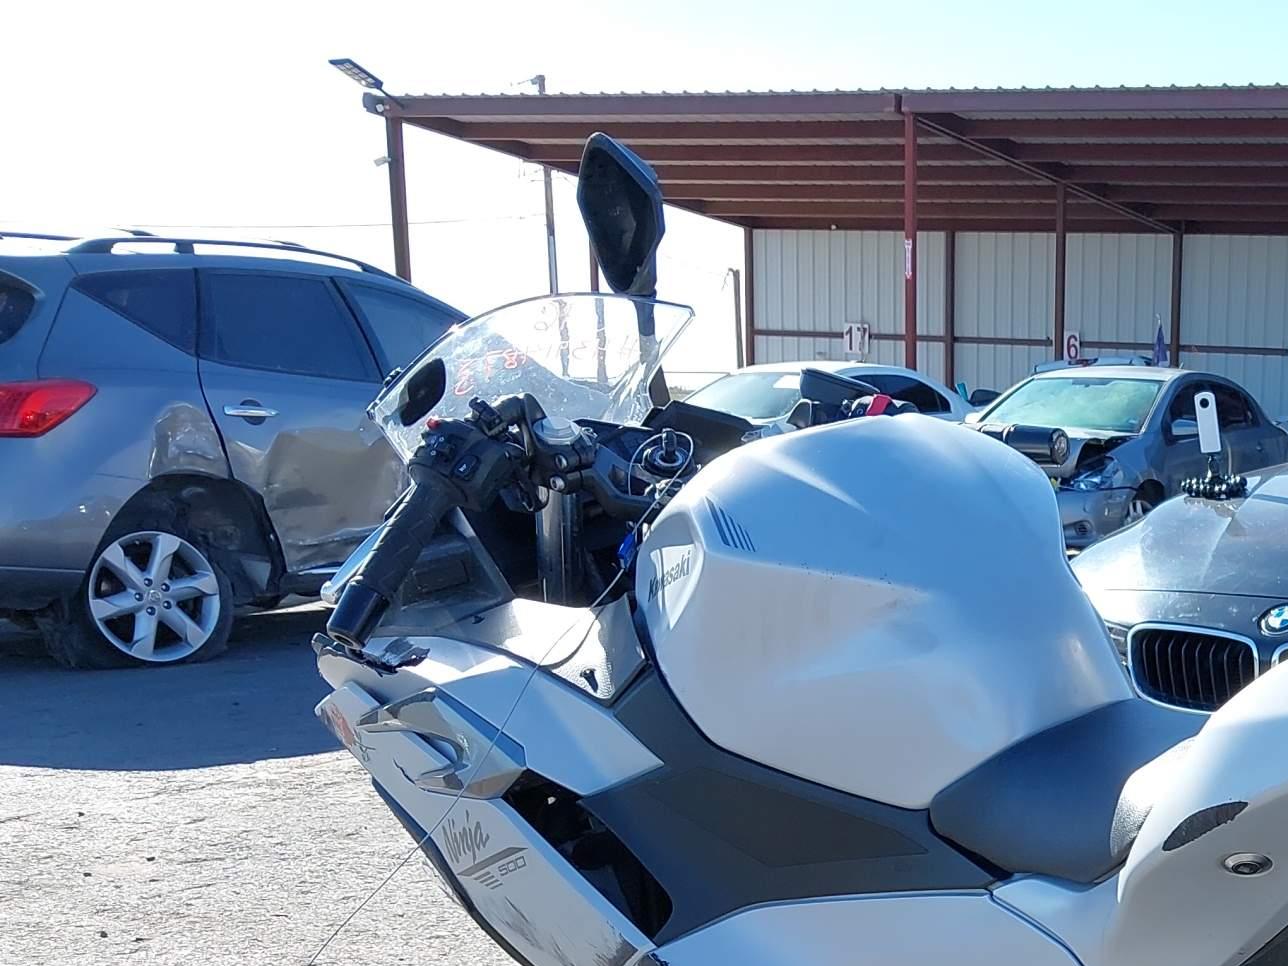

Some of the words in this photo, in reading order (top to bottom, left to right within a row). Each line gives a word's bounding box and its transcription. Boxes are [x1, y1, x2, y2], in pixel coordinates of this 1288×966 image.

[845, 325, 867, 351] 17
[648, 549, 691, 603] Kawasaki
[442, 809, 490, 865] Ninja
[498, 856, 527, 876] 500
